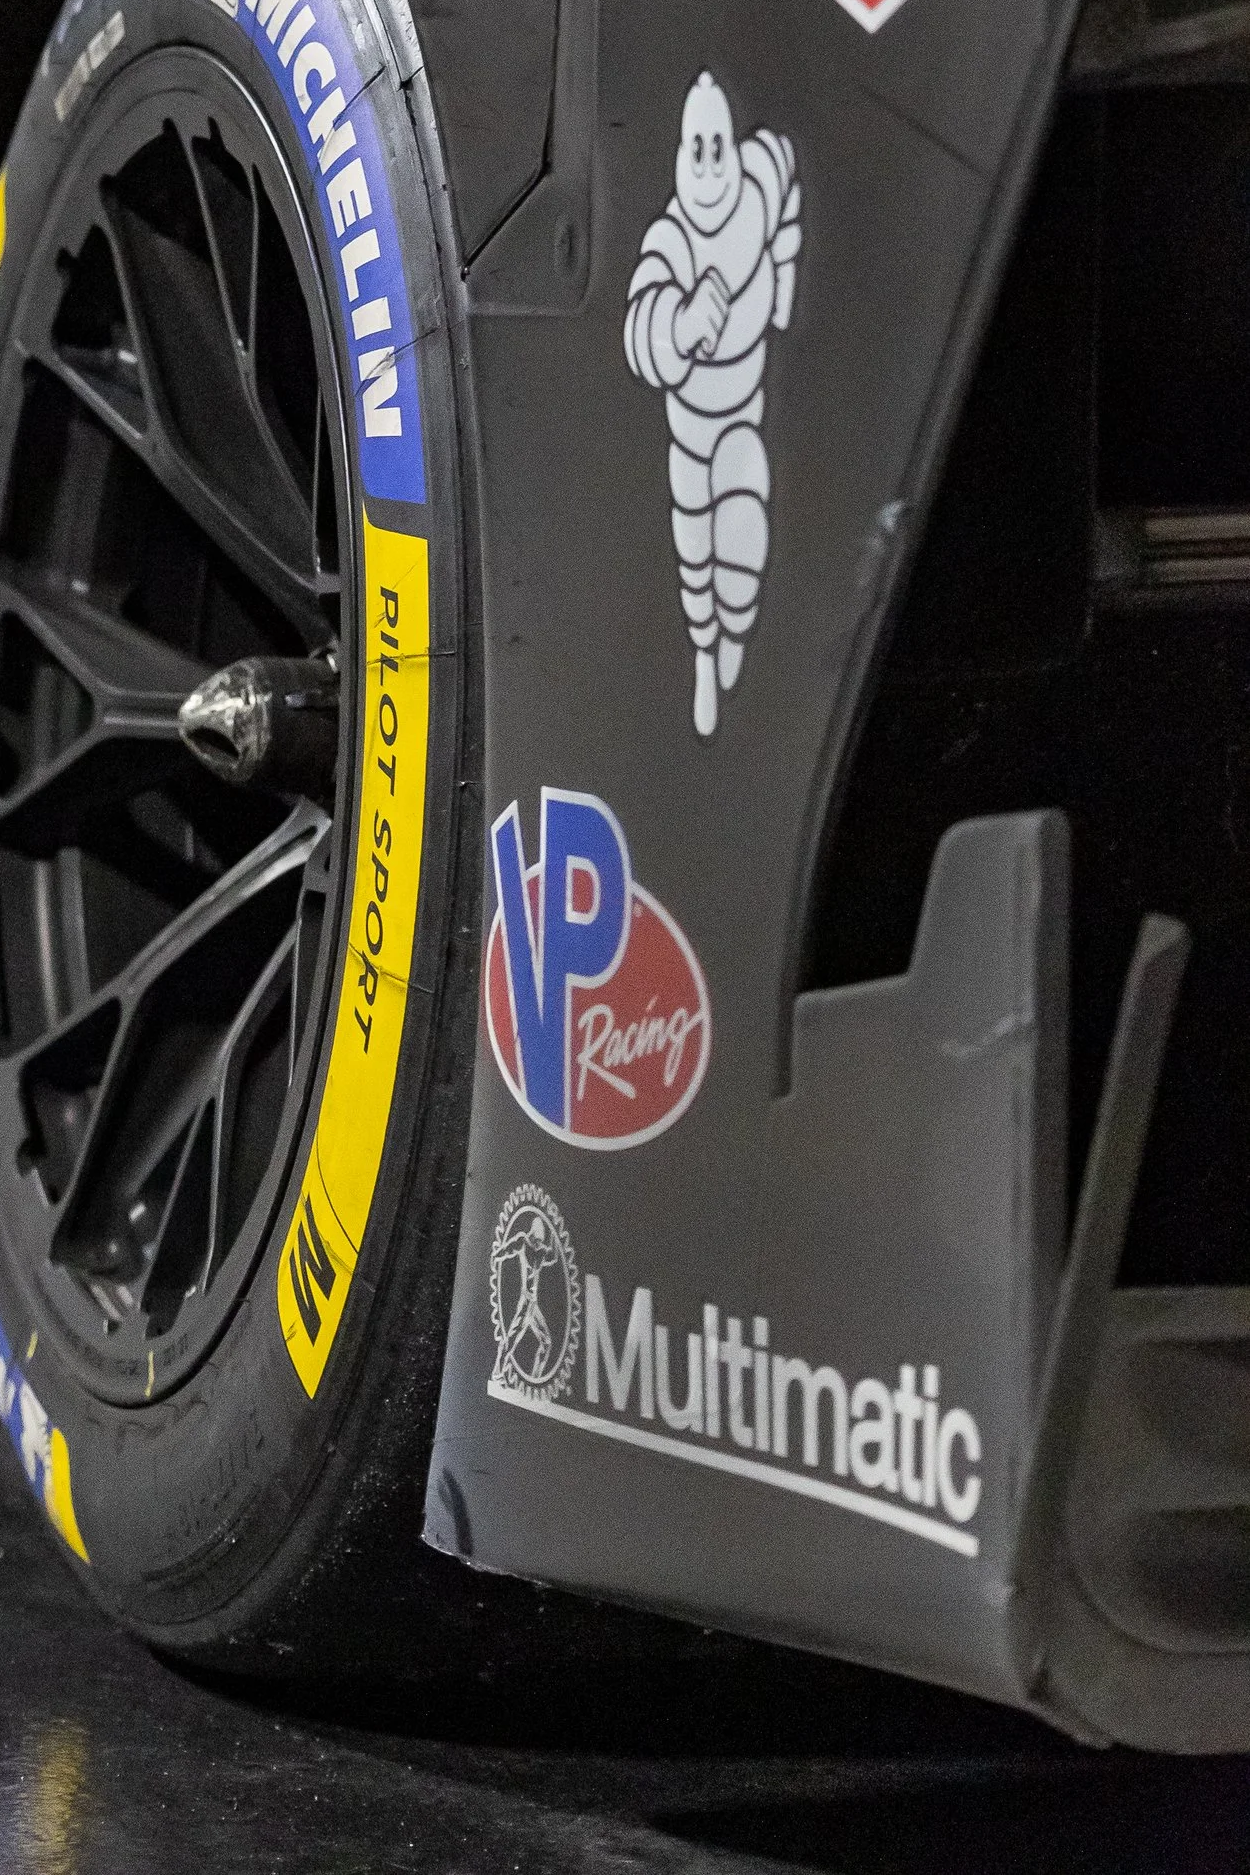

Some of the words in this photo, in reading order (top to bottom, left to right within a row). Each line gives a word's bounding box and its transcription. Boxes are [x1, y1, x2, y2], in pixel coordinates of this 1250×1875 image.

[378, 586, 399, 796] PILOT
[352, 809, 392, 1054] SPORT
[491, 786, 632, 1131] VP
[577, 996, 701, 1101] Racing
[584, 1273, 982, 1523] Multimatic
